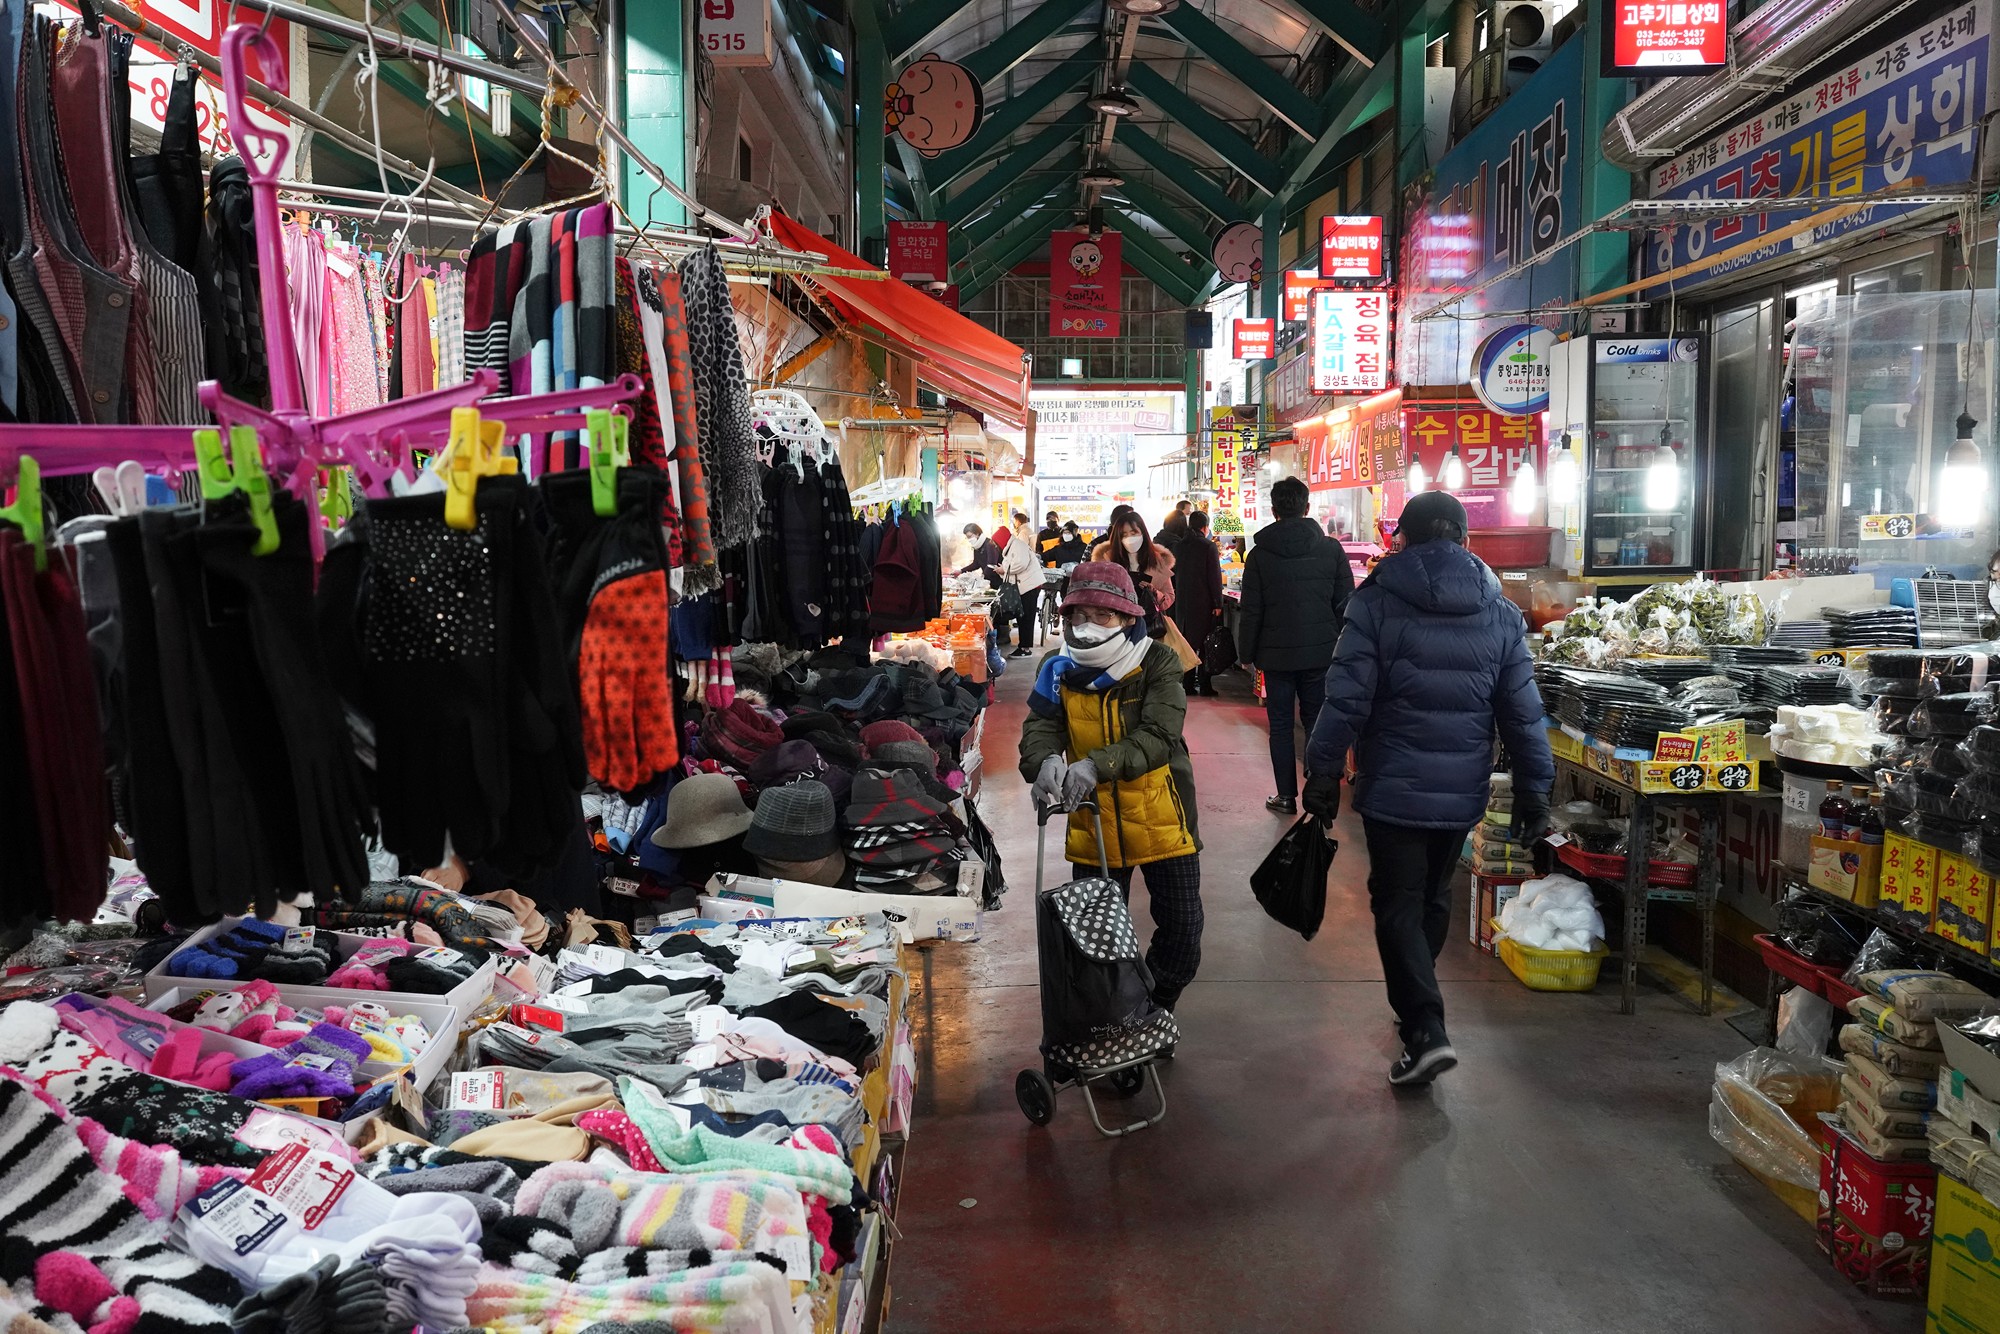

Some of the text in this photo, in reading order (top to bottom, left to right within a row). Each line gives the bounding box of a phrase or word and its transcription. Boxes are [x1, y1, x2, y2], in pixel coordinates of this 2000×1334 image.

[1624, 3, 1719, 26] 고추기름상회
[1636, 29, 1706, 38] 033-646-3437
[1636, 38, 1706, 47] 010-5367-3437
[1660, 52, 1682, 63] 193
[1657, 5, 1976, 188] 고추 참기름 들기름 마늘 젓갈류 각종 도산매
[1494, 98, 1568, 278] 매장
[1325, 236, 1379, 250] LA갈비매장
[1322, 295, 1347, 373] LA갈비
[1353, 296, 1381, 373] 정육점
[1606, 345, 1661, 356] Cold Drinks
[1323, 375, 1379, 386] 경상도 식육점
[1498, 364, 1550, 377] 중앙고추기름상
[1374, 430, 1401, 451] 갈비살
[1410, 413, 1537, 446] 수입육
[1310, 423, 1359, 484] LA갈비
[1360, 424, 1369, 477] 매장
[1216, 416, 1237, 508] 대림반찬
[1412, 444, 1538, 486] A갈비
[1886, 518, 1911, 535] 곱창
[1660, 746, 1691, 757] 부정유통
[1672, 766, 1702, 788] 곱창
[1720, 766, 1749, 788] 곱창
[1885, 845, 1901, 896] 名品
[1910, 855, 1926, 907] 名品
